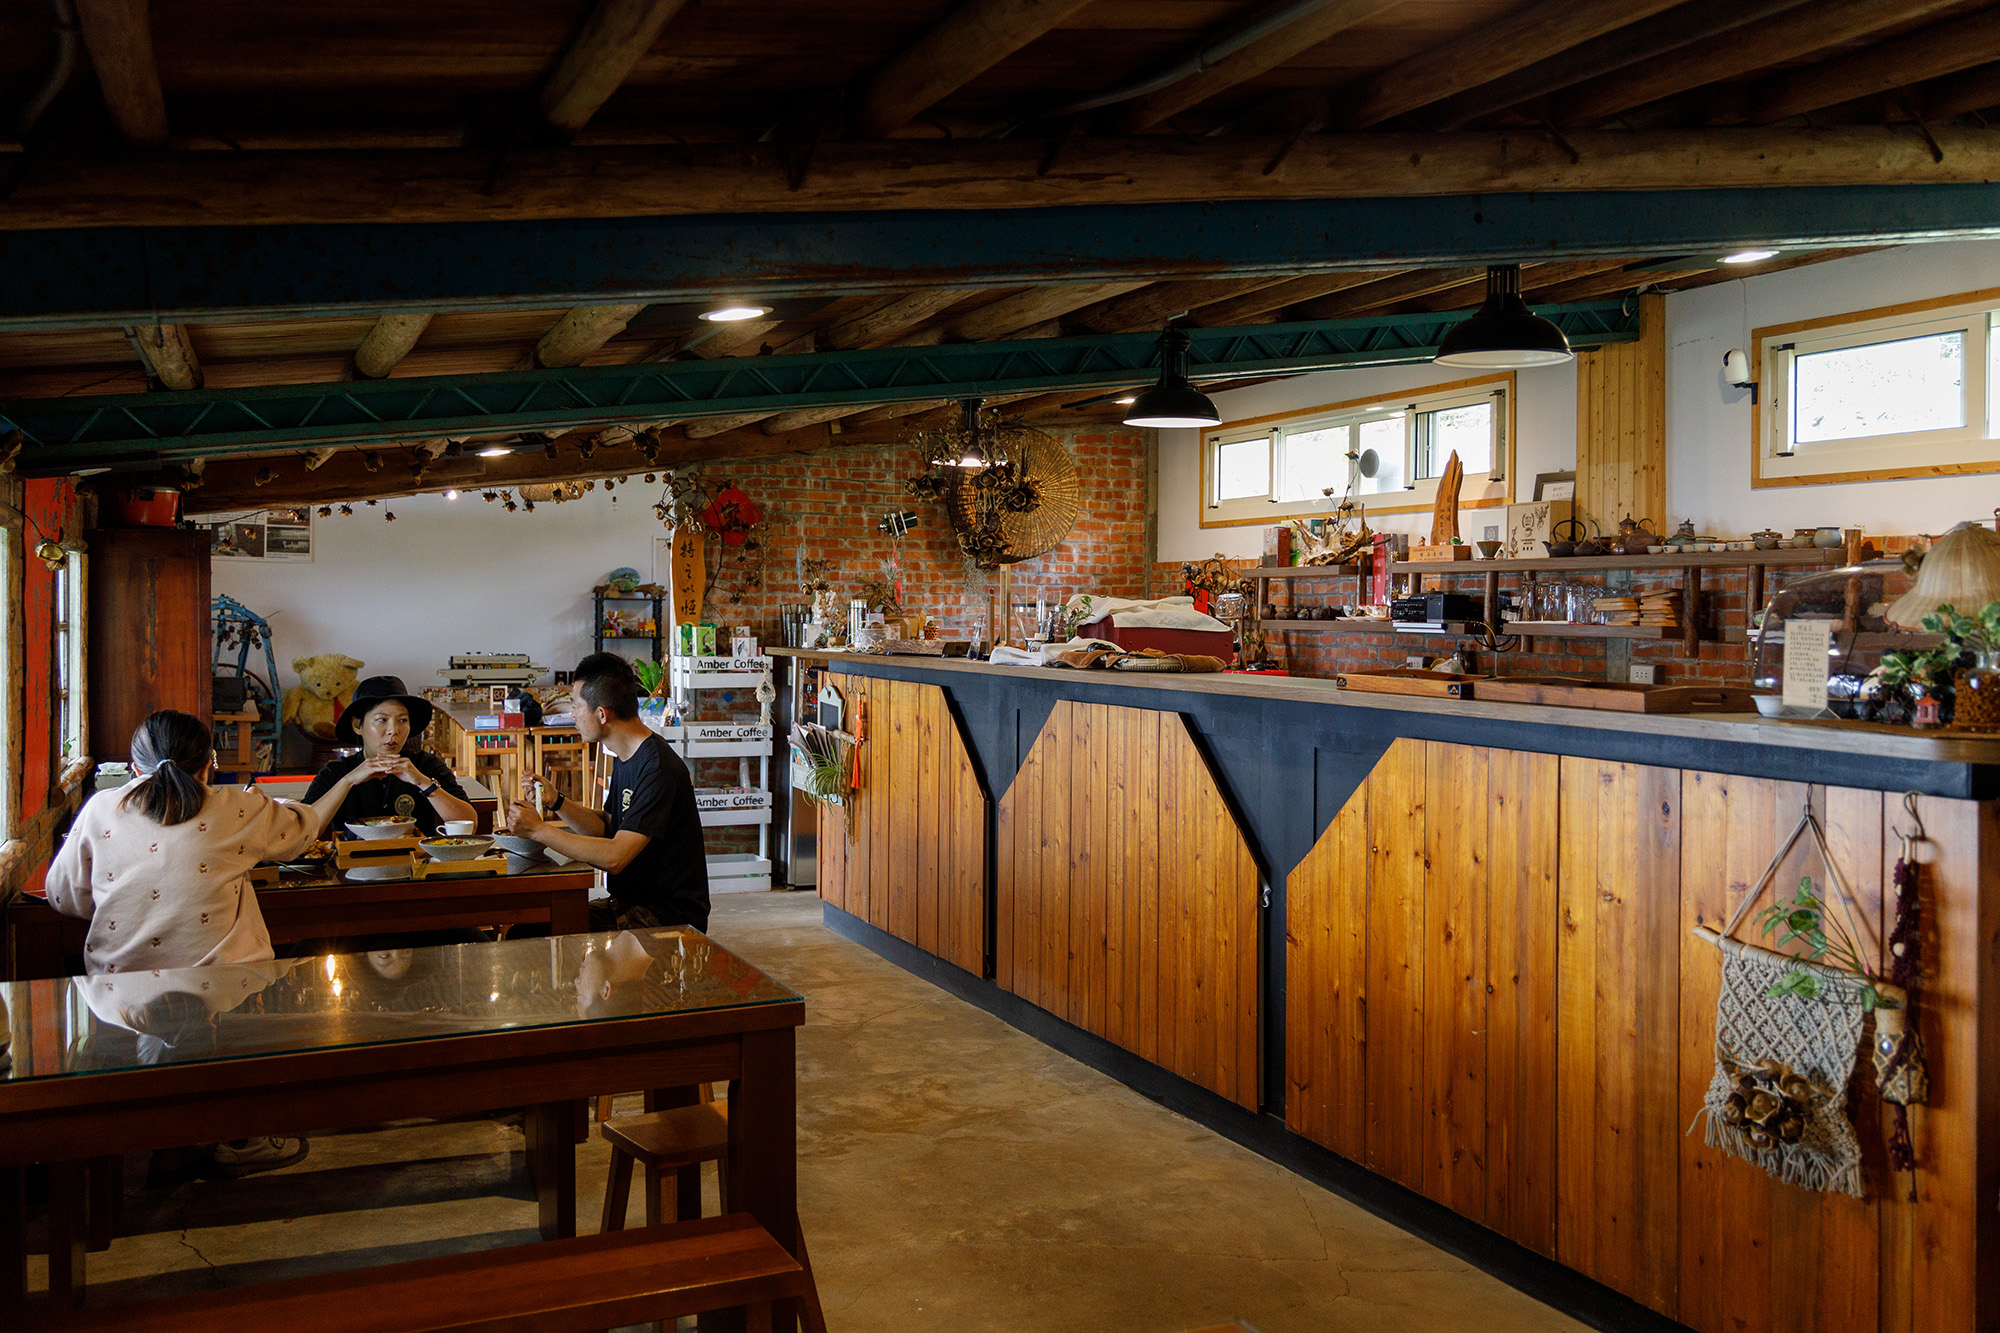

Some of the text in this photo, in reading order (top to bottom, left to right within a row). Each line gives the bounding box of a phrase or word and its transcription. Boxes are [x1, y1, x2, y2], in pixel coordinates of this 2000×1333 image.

[697, 659, 765, 669] Amber Coffee
[700, 727, 768, 737] Amber Coffee
[697, 796, 763, 807] Amber Coffee
